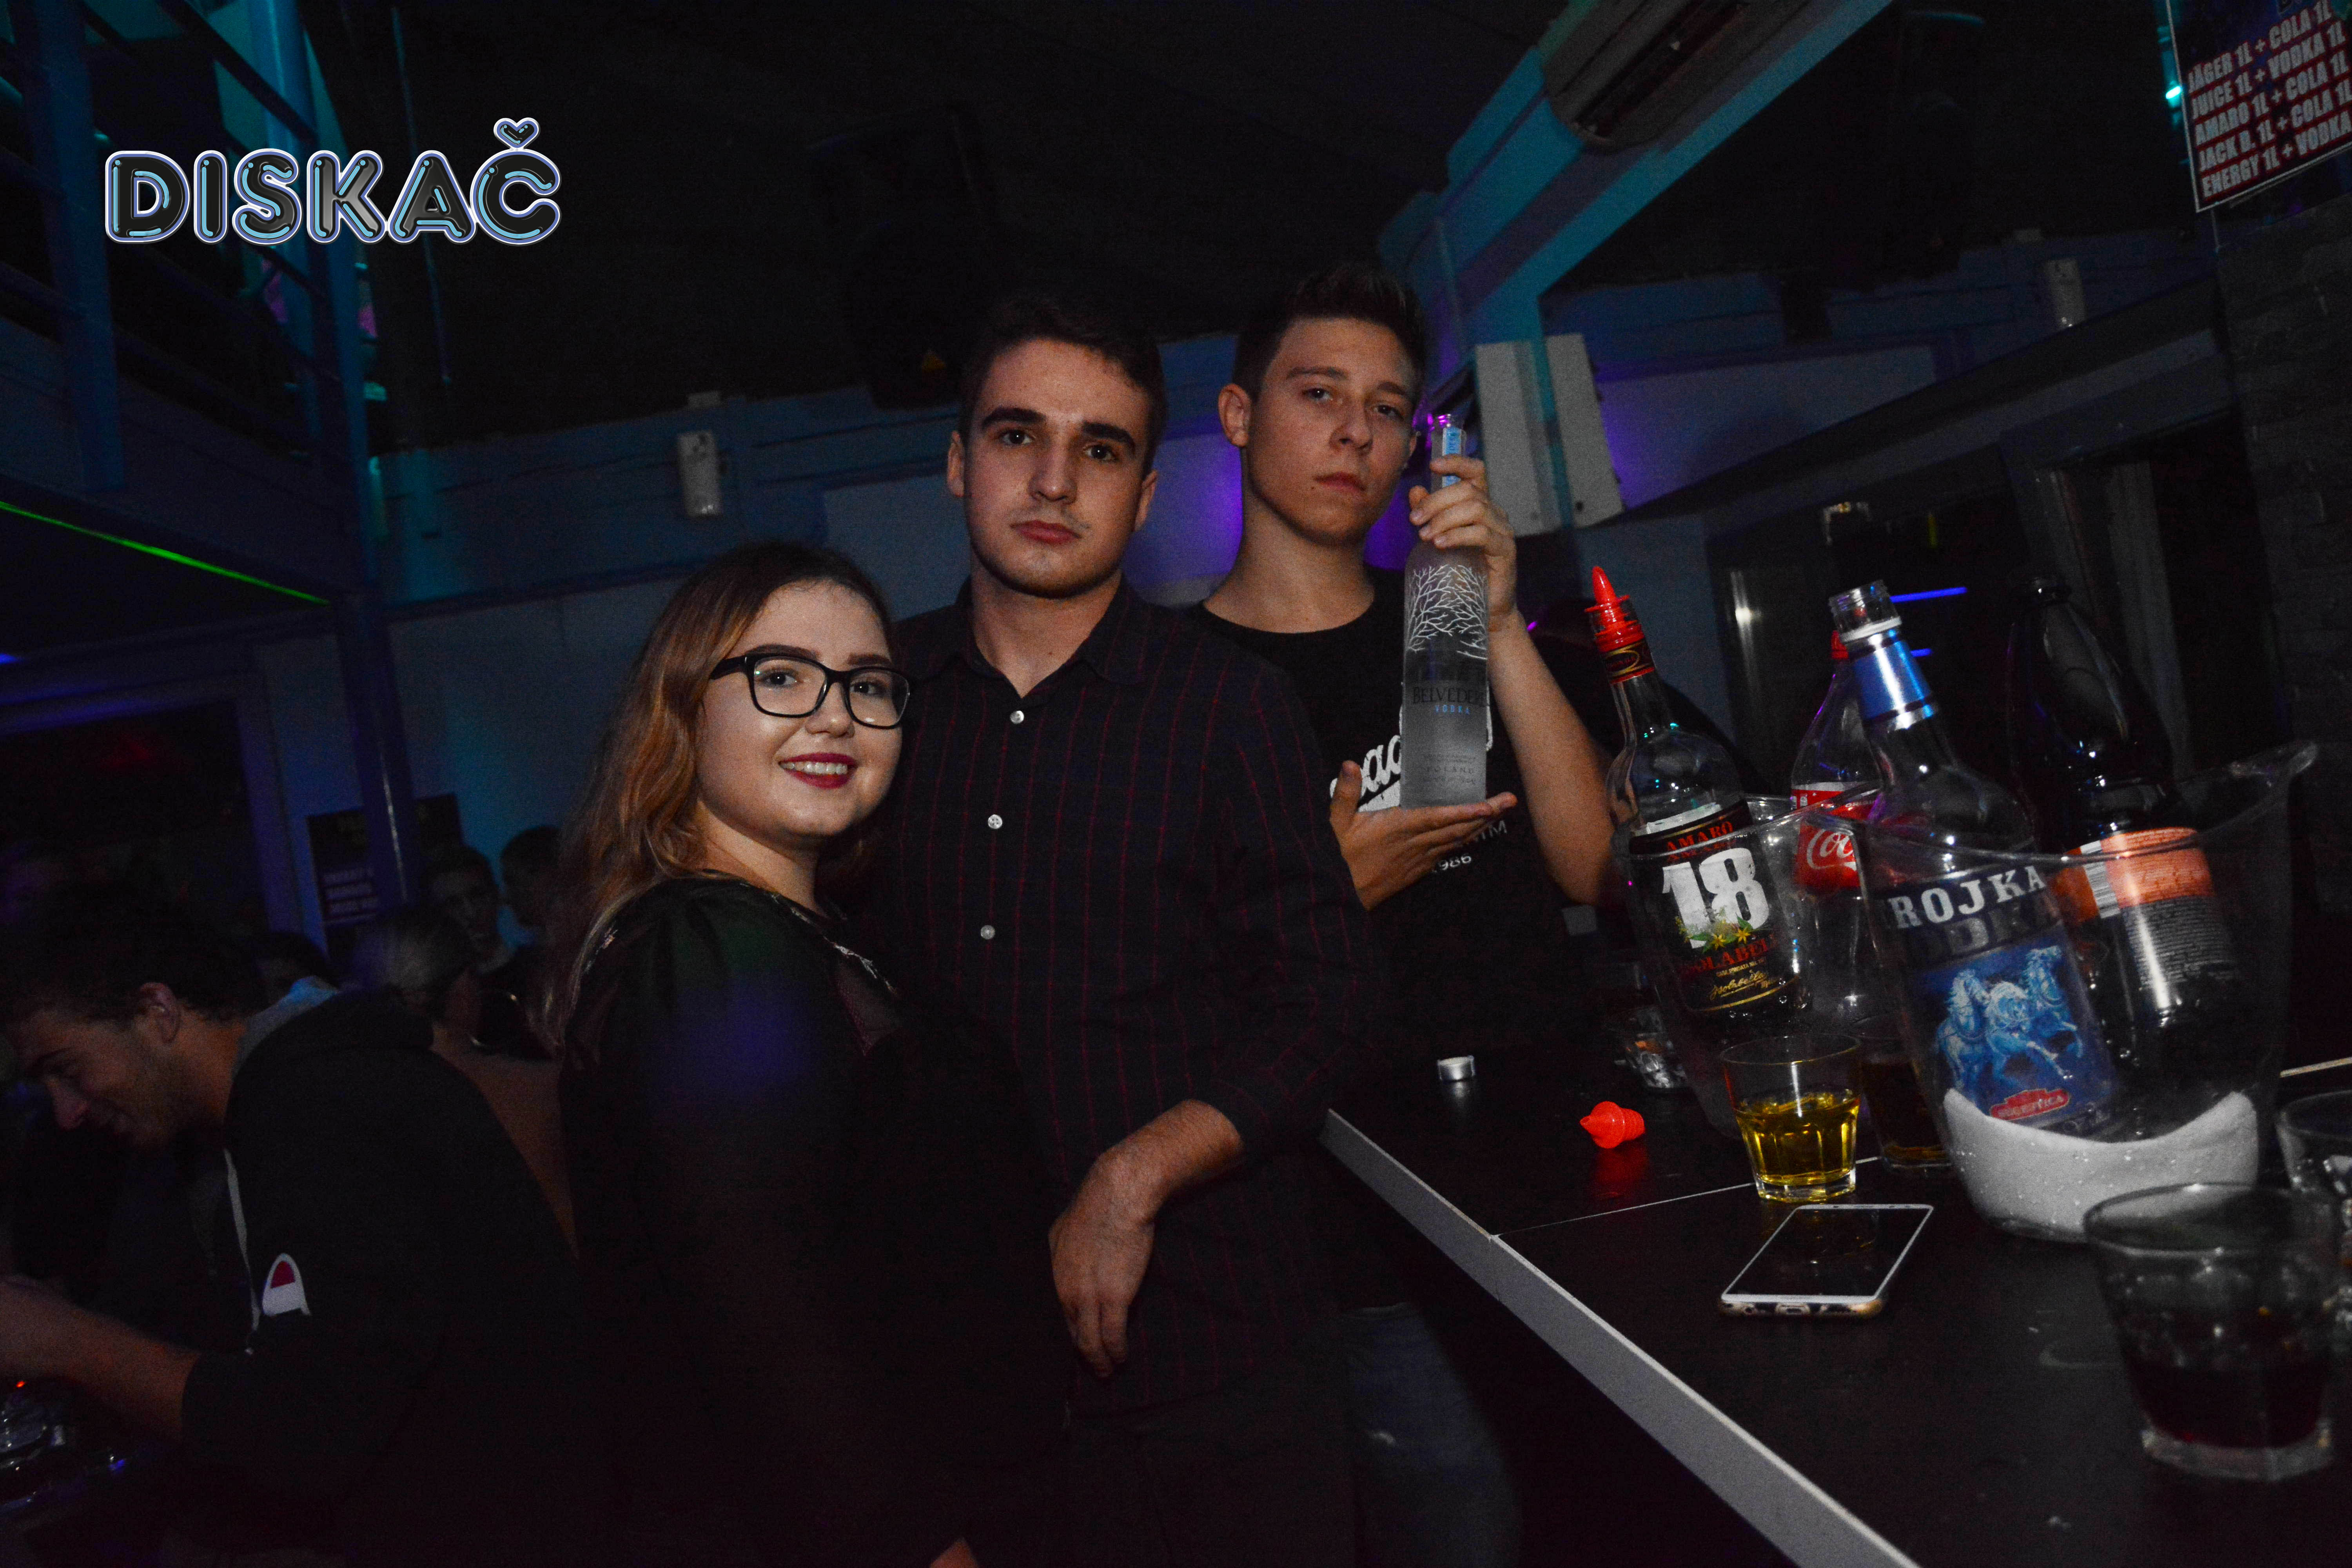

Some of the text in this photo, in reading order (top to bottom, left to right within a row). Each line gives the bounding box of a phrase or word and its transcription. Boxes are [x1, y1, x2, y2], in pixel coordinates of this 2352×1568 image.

[2192, 21, 2346, 119] JUICE 1L + VODKA 1L
[2235, 42, 2253, 67] 1L
[2256, 39, 2265, 53] +
[2269, 9, 2312, 50] COLA
[2314, 0, 2332, 24] 1L
[2196, 50, 2349, 146] AMARO 1L + COLA 1L
[2199, 136, 2238, 172] JACK
[2257, 119, 2275, 143] 1L
[2277, 116, 2288, 130] +
[2291, 89, 2334, 128] COLA
[2335, 79, 2352, 105] 1L
[2202, 110, 2352, 198] ENERGY 1L + VODKA
[1434, 704, 1470, 715] VODKA
[1666, 821, 1734, 851] AMARO
[1662, 847, 1771, 949] 18
[1880, 865, 2046, 929] ROJKA
